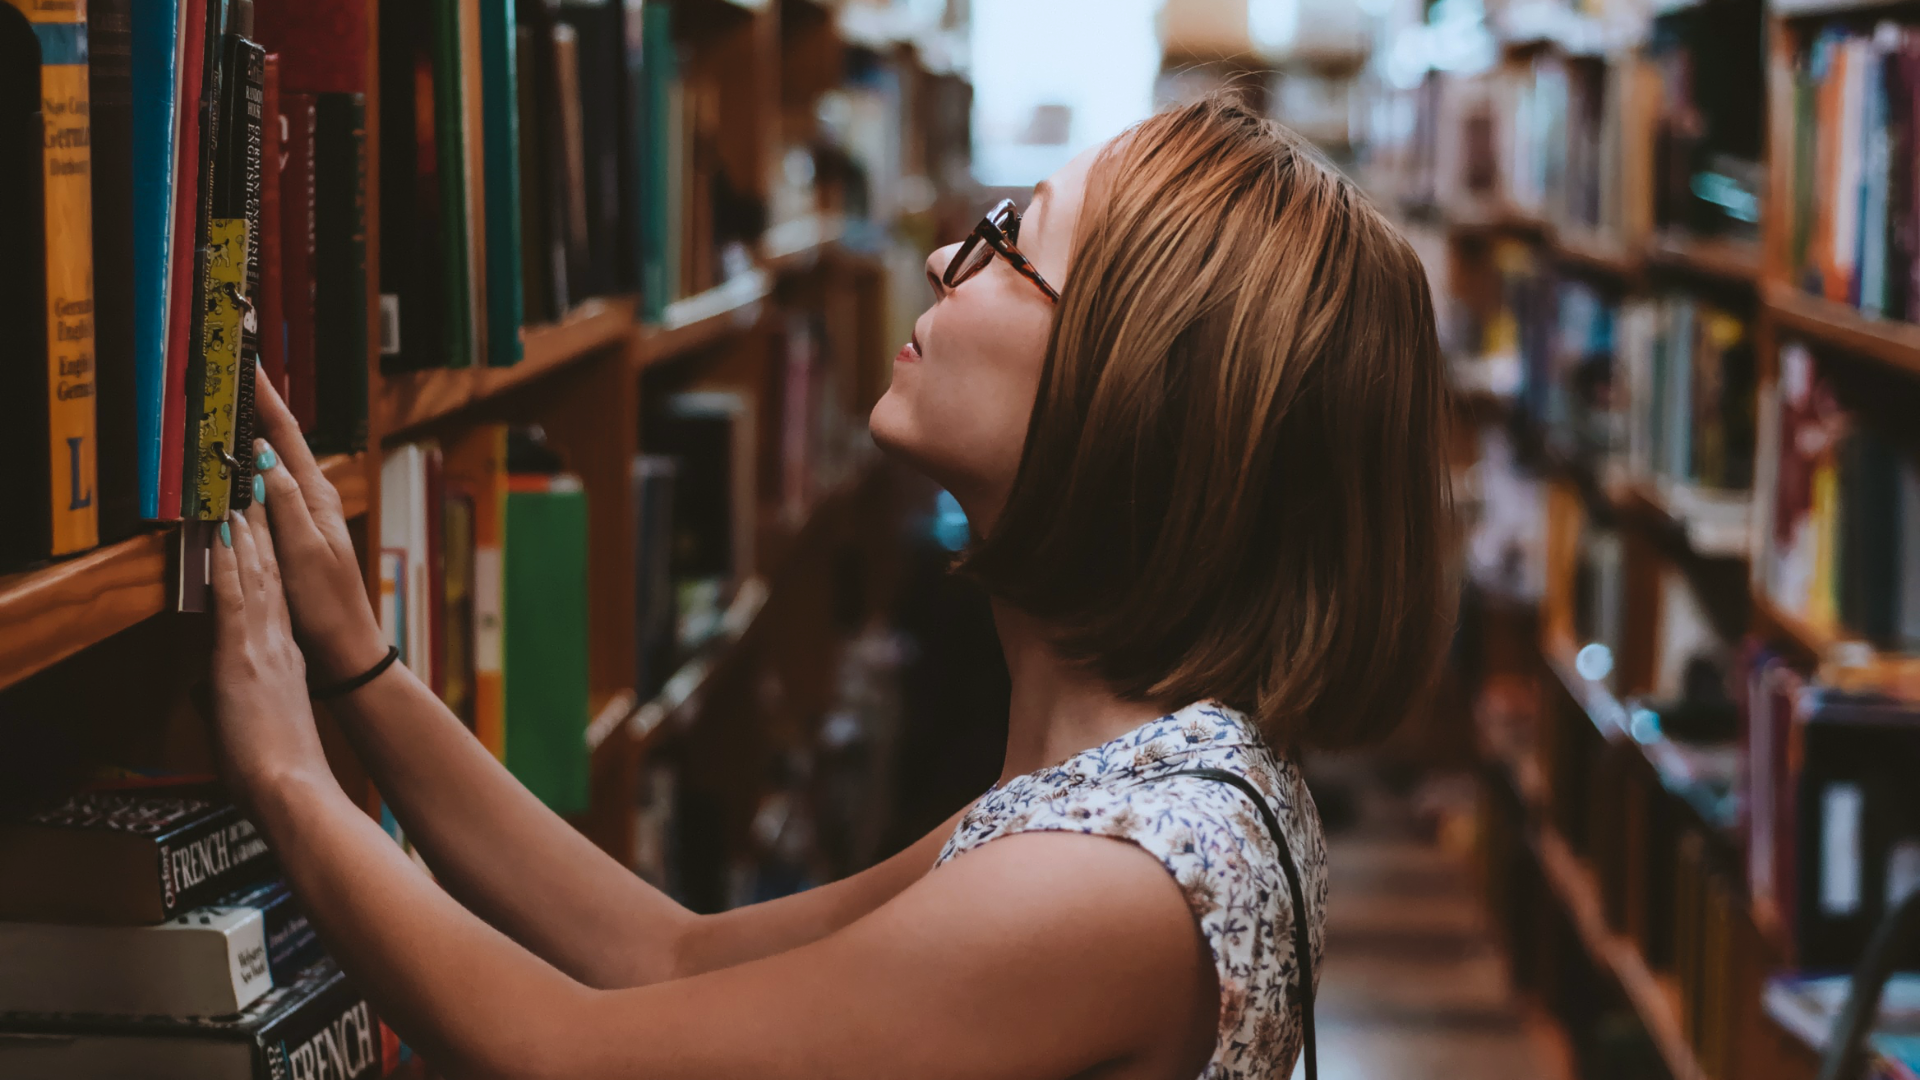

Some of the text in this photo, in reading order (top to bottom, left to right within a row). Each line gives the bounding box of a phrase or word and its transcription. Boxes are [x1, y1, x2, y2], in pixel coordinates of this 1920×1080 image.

[251, 125, 261, 268] GERMAN-ENGLISH
[67, 437, 92, 511] L
[171, 828, 231, 893] FRENCH
